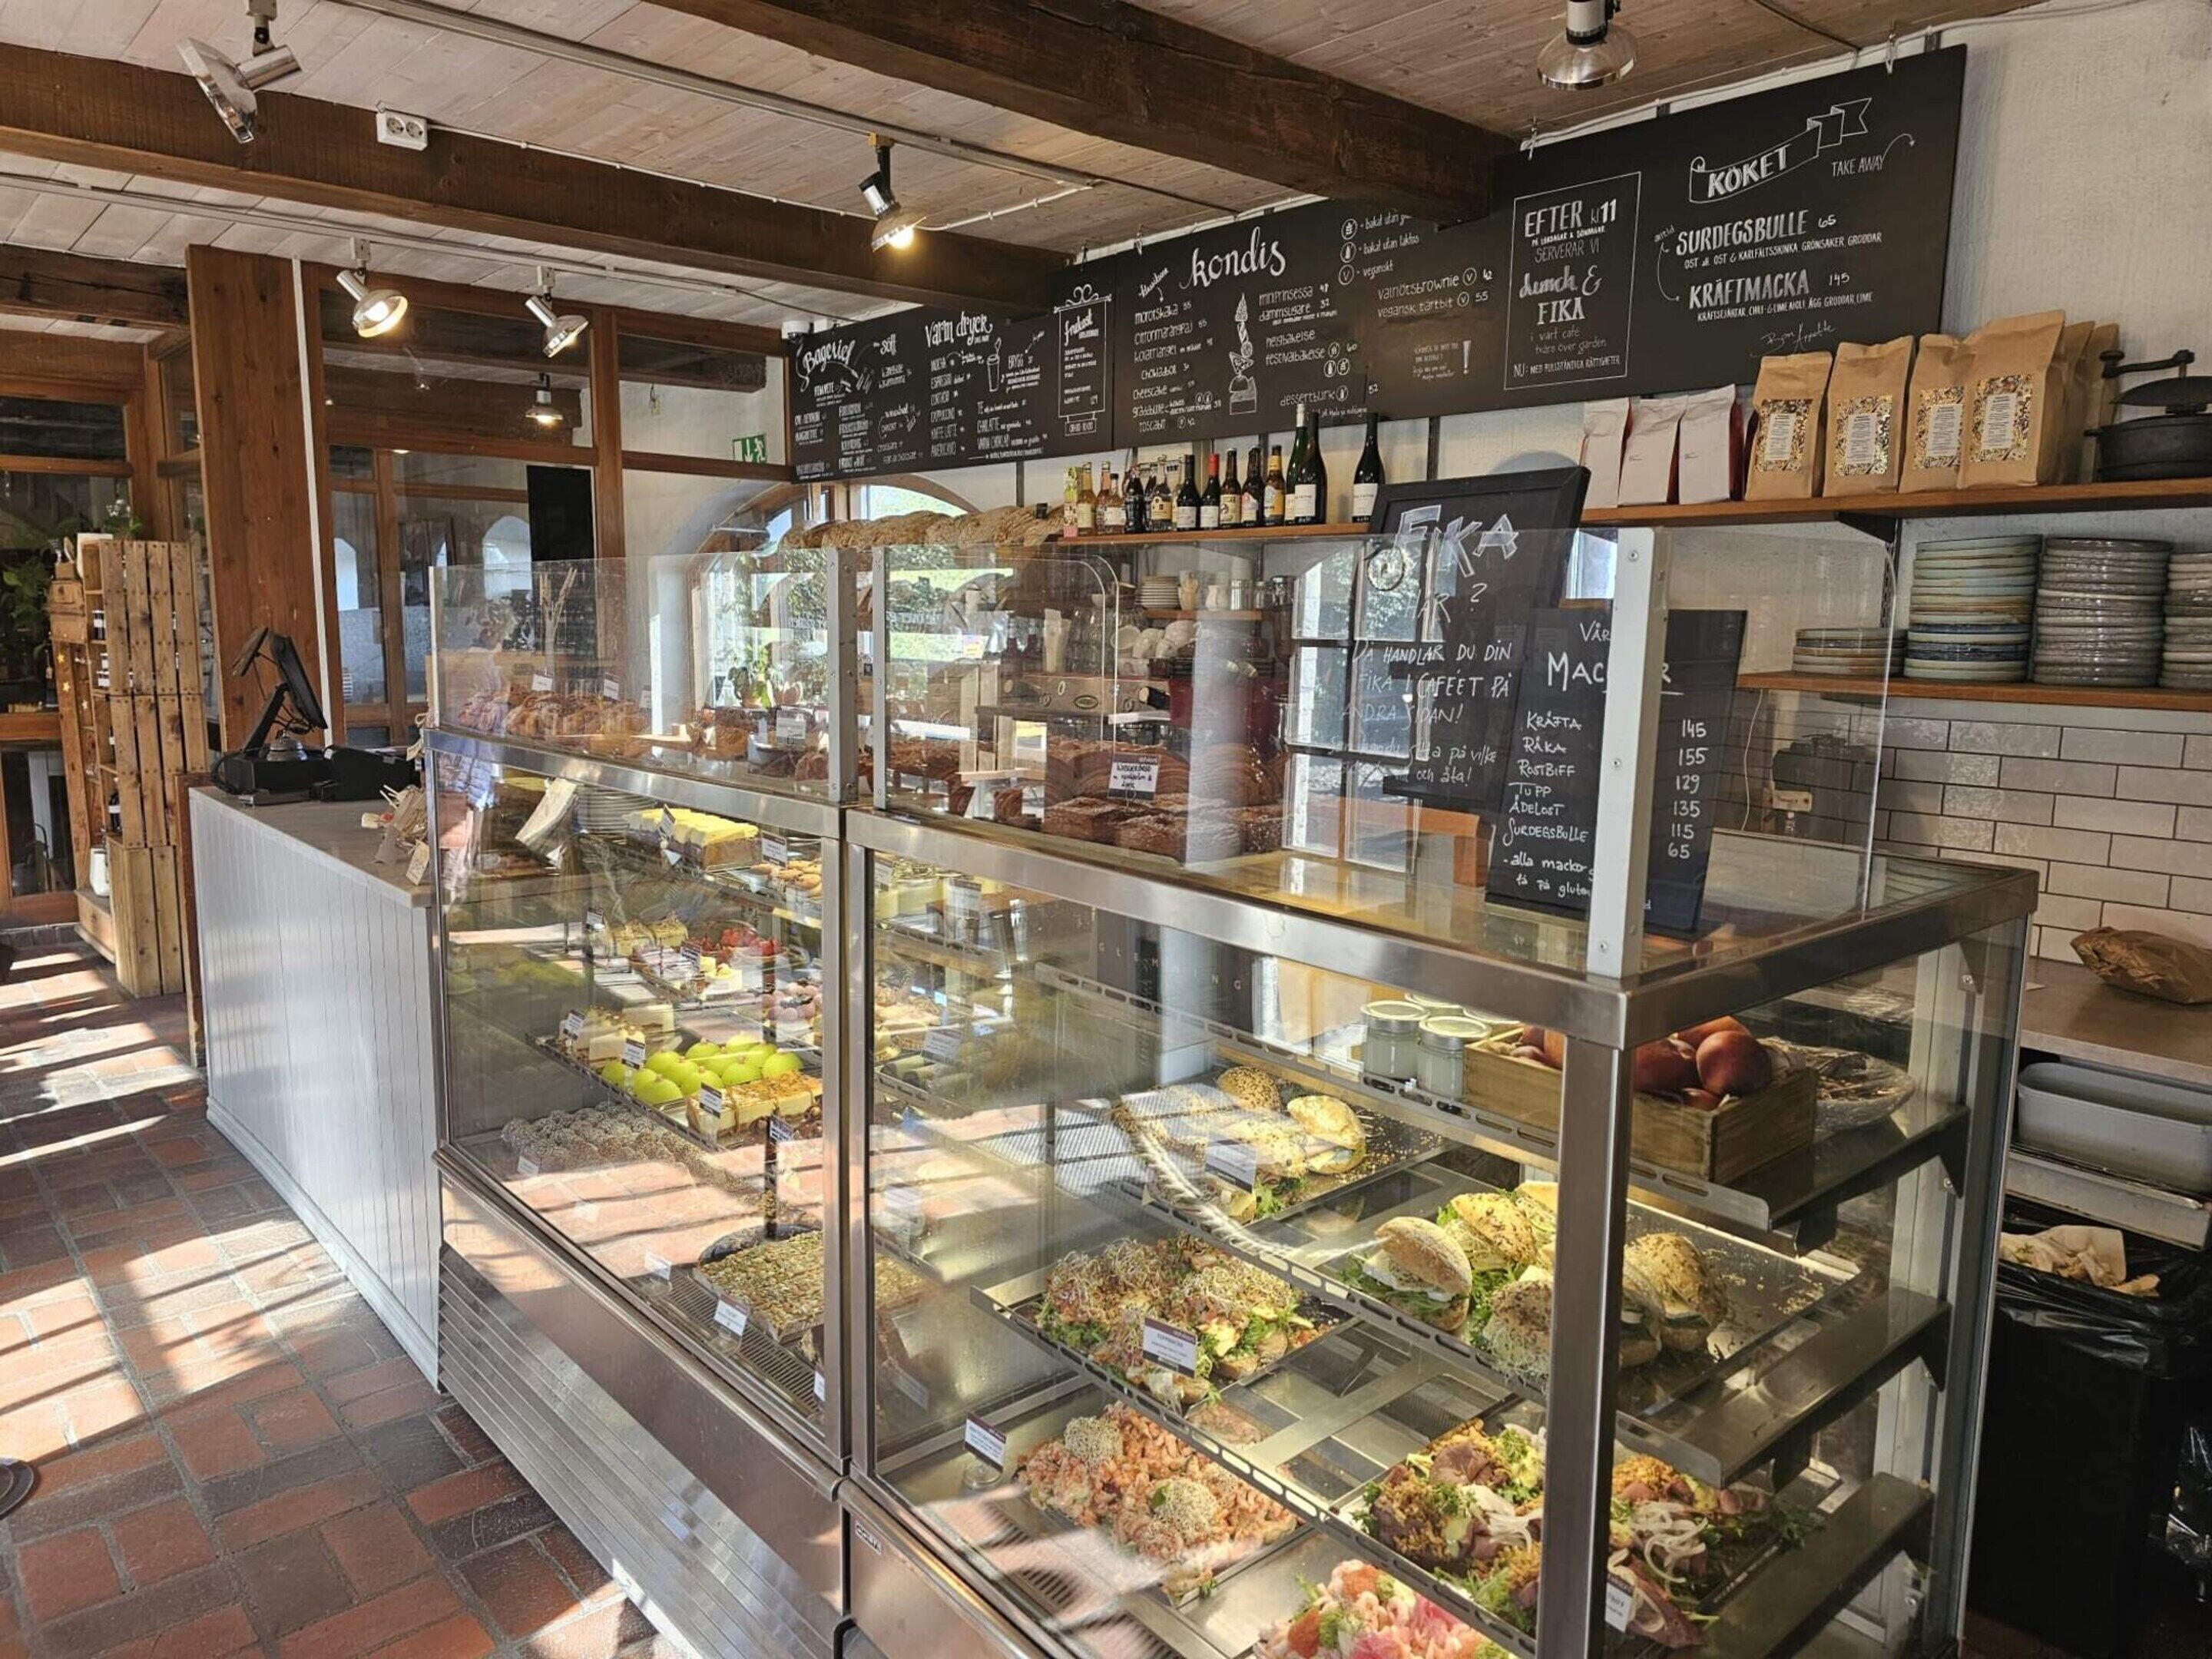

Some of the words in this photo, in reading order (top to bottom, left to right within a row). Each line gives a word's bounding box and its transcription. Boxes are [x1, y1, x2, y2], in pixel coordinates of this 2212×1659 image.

[1707, 143, 1791, 198] KÖKET
[1832, 158, 1856, 177] TAKE
[1858, 154, 1883, 174] AWAY
[1524, 200, 1583, 237] EFTER
[1676, 210, 1810, 257] SURDEGSBULLE
[1818, 214, 1837, 228] 65
[1179, 226, 1286, 290] kondis
[1535, 239, 1585, 263] SERVERAR
[1590, 237, 1600, 254] VI
[1684, 257, 1699, 270] OST
[1714, 253, 1728, 265] OST
[1847, 231, 1883, 246] GRODDAR
[1363, 260, 1394, 280] veganskt
[1519, 265, 1578, 299] lunch
[1581, 265, 1603, 296] &
[1378, 274, 1460, 301] valnötsbrownie
[1689, 269, 1810, 310] KRÄFTMACKA
[1829, 273, 1850, 286] 145
[1134, 303, 1179, 326] morotskaka
[1377, 303, 1416, 319] vegansk
[1475, 290, 1489, 303] 55
[1537, 296, 1586, 325] FIKA
[925, 320, 955, 348] Varm
[956, 310, 994, 346] dryck
[803, 339, 856, 376] Bageriet
[1393, 504, 1519, 578] FIKA
[1383, 644, 1445, 666] HANDLAR
[1456, 644, 1475, 661] DU
[1484, 639, 1512, 661] DIN
[1491, 671, 1512, 698] PÅ
[1682, 719, 1707, 739] 145
[1678, 747, 1709, 767] 155
[1416, 769, 1435, 783] och
[1517, 759, 1575, 778] ROSTBIFF
[1676, 774, 1700, 794] 129
[1674, 800, 1701, 818] 135
[1502, 817, 1591, 846] SURDEGSBULLE
[1667, 843, 1690, 859] 65
[1671, 823, 1694, 840] 115
